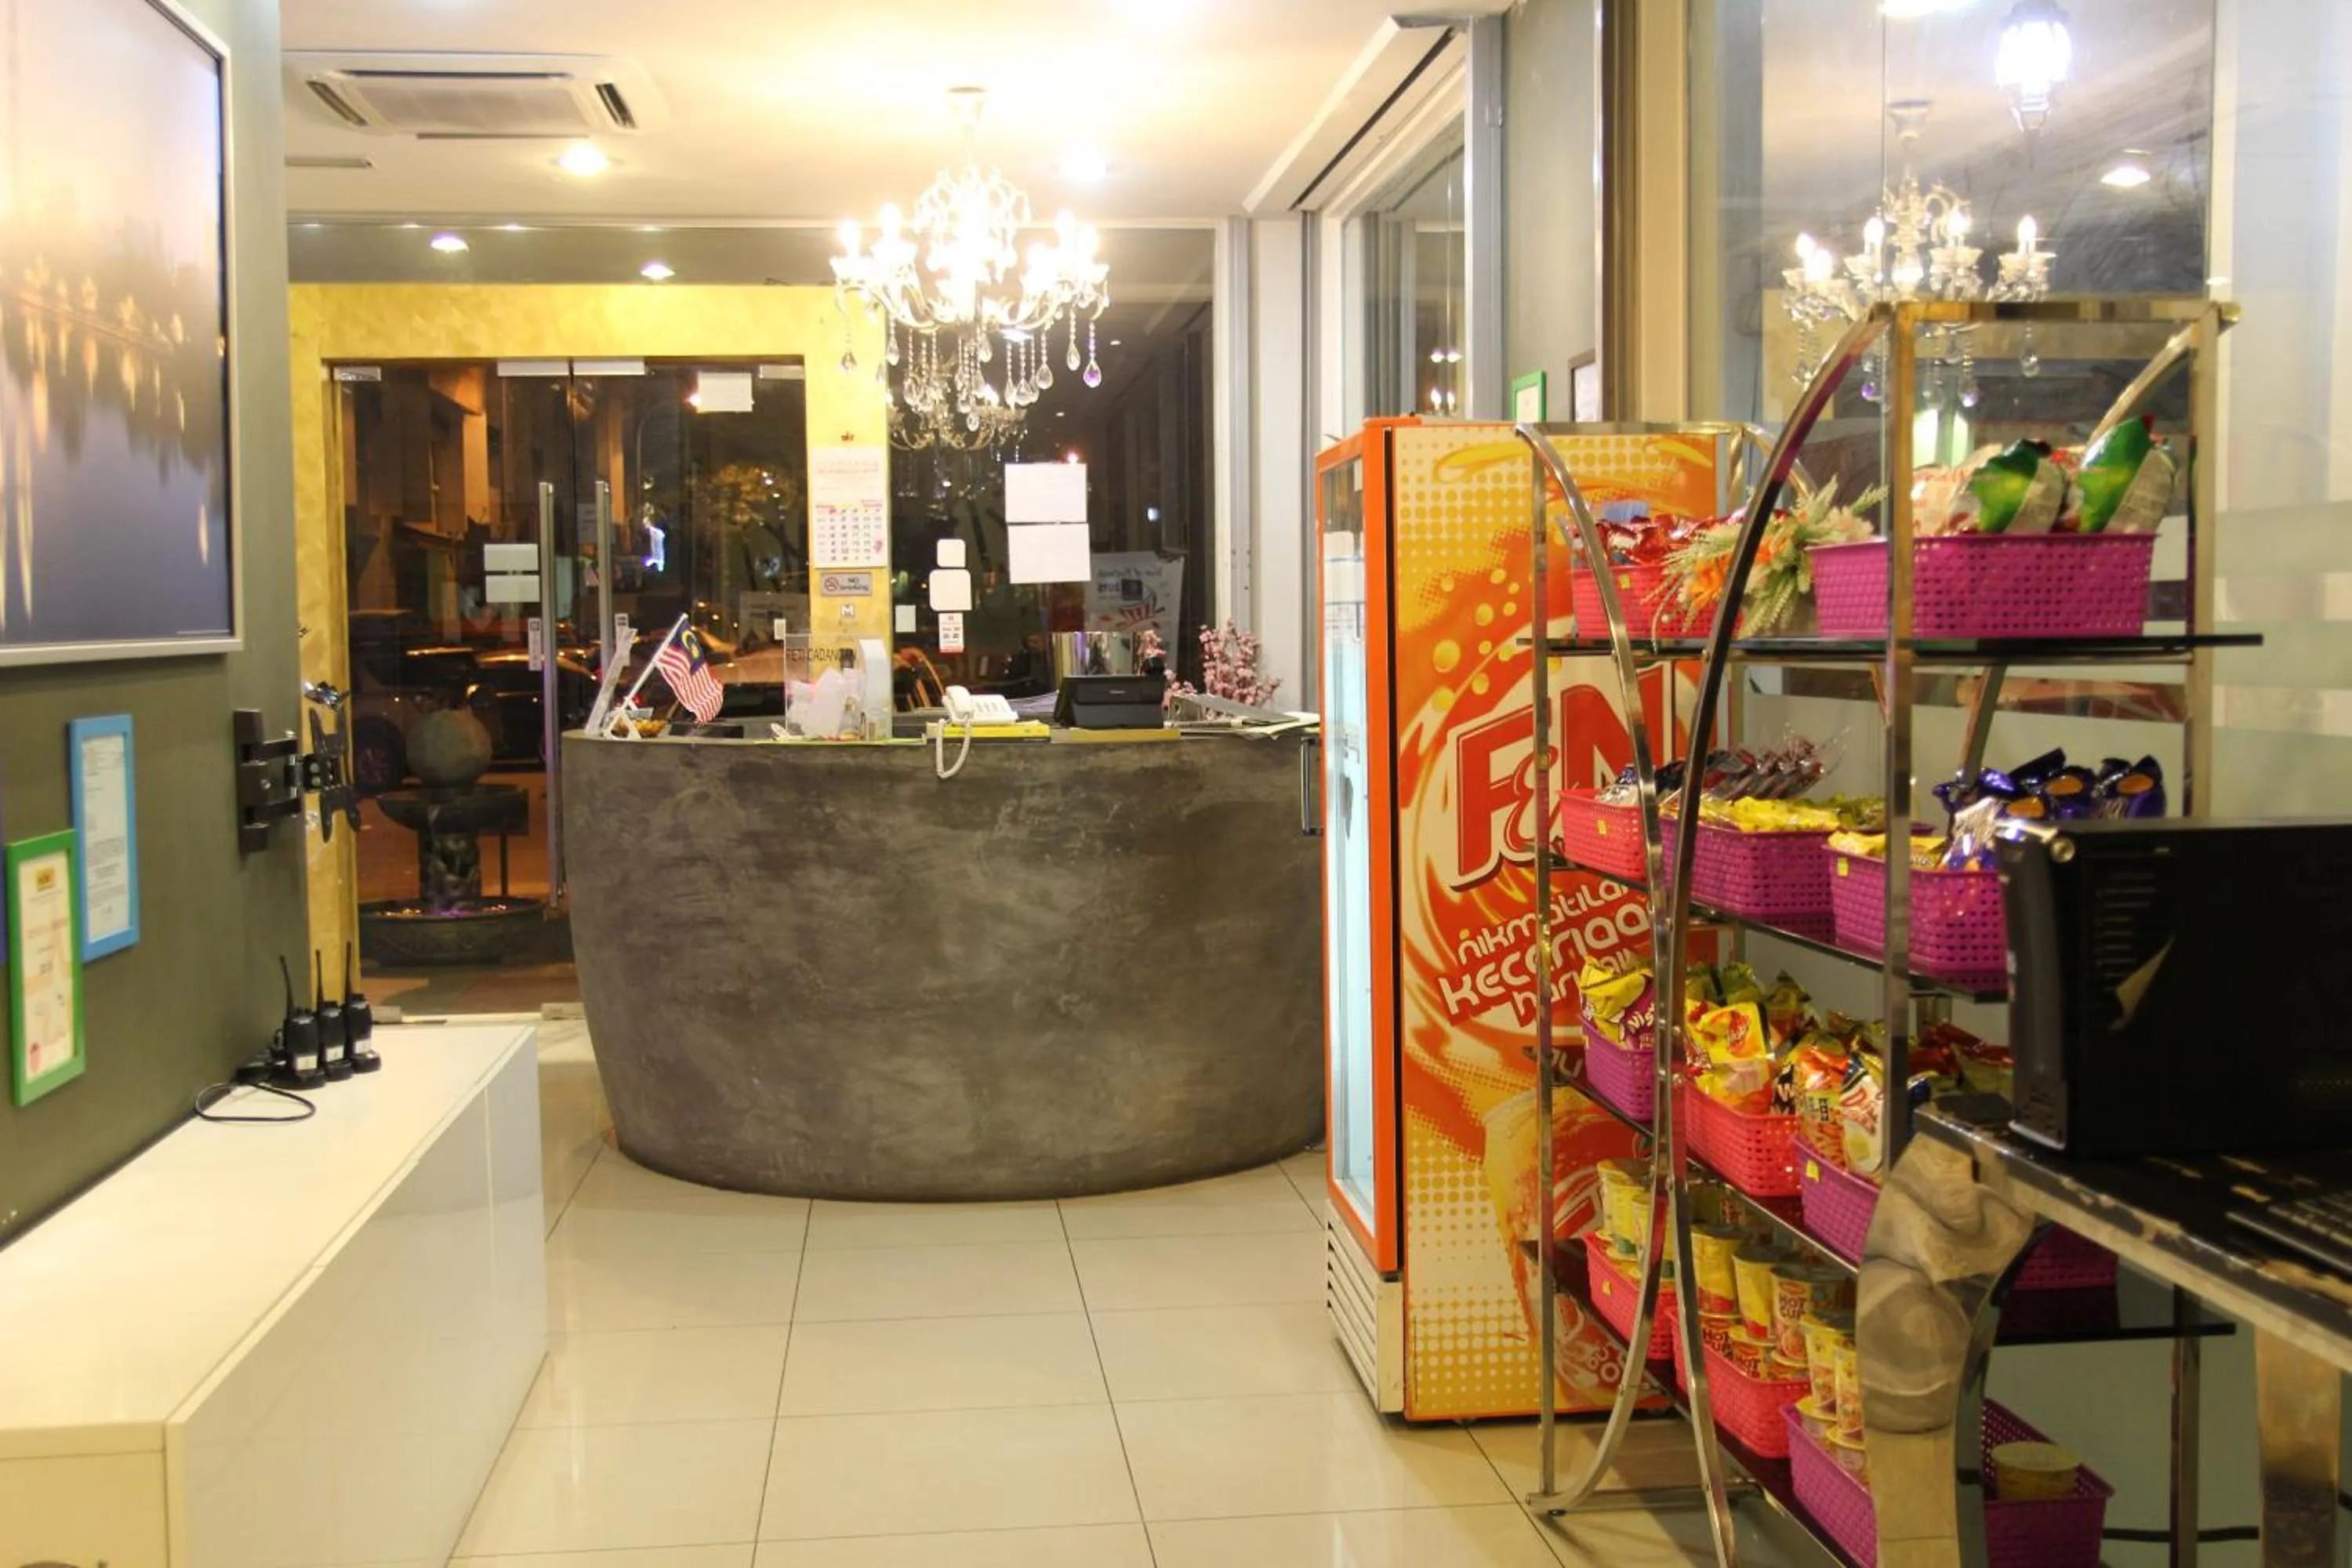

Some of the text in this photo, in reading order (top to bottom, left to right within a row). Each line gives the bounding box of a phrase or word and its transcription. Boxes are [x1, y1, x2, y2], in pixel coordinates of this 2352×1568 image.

[1450, 660, 1671, 886] F&N
[1439, 903, 1653, 1016] keceriaa
[1457, 879, 1629, 966] nikmatila
[1779, 1295, 1806, 1308] HOT
